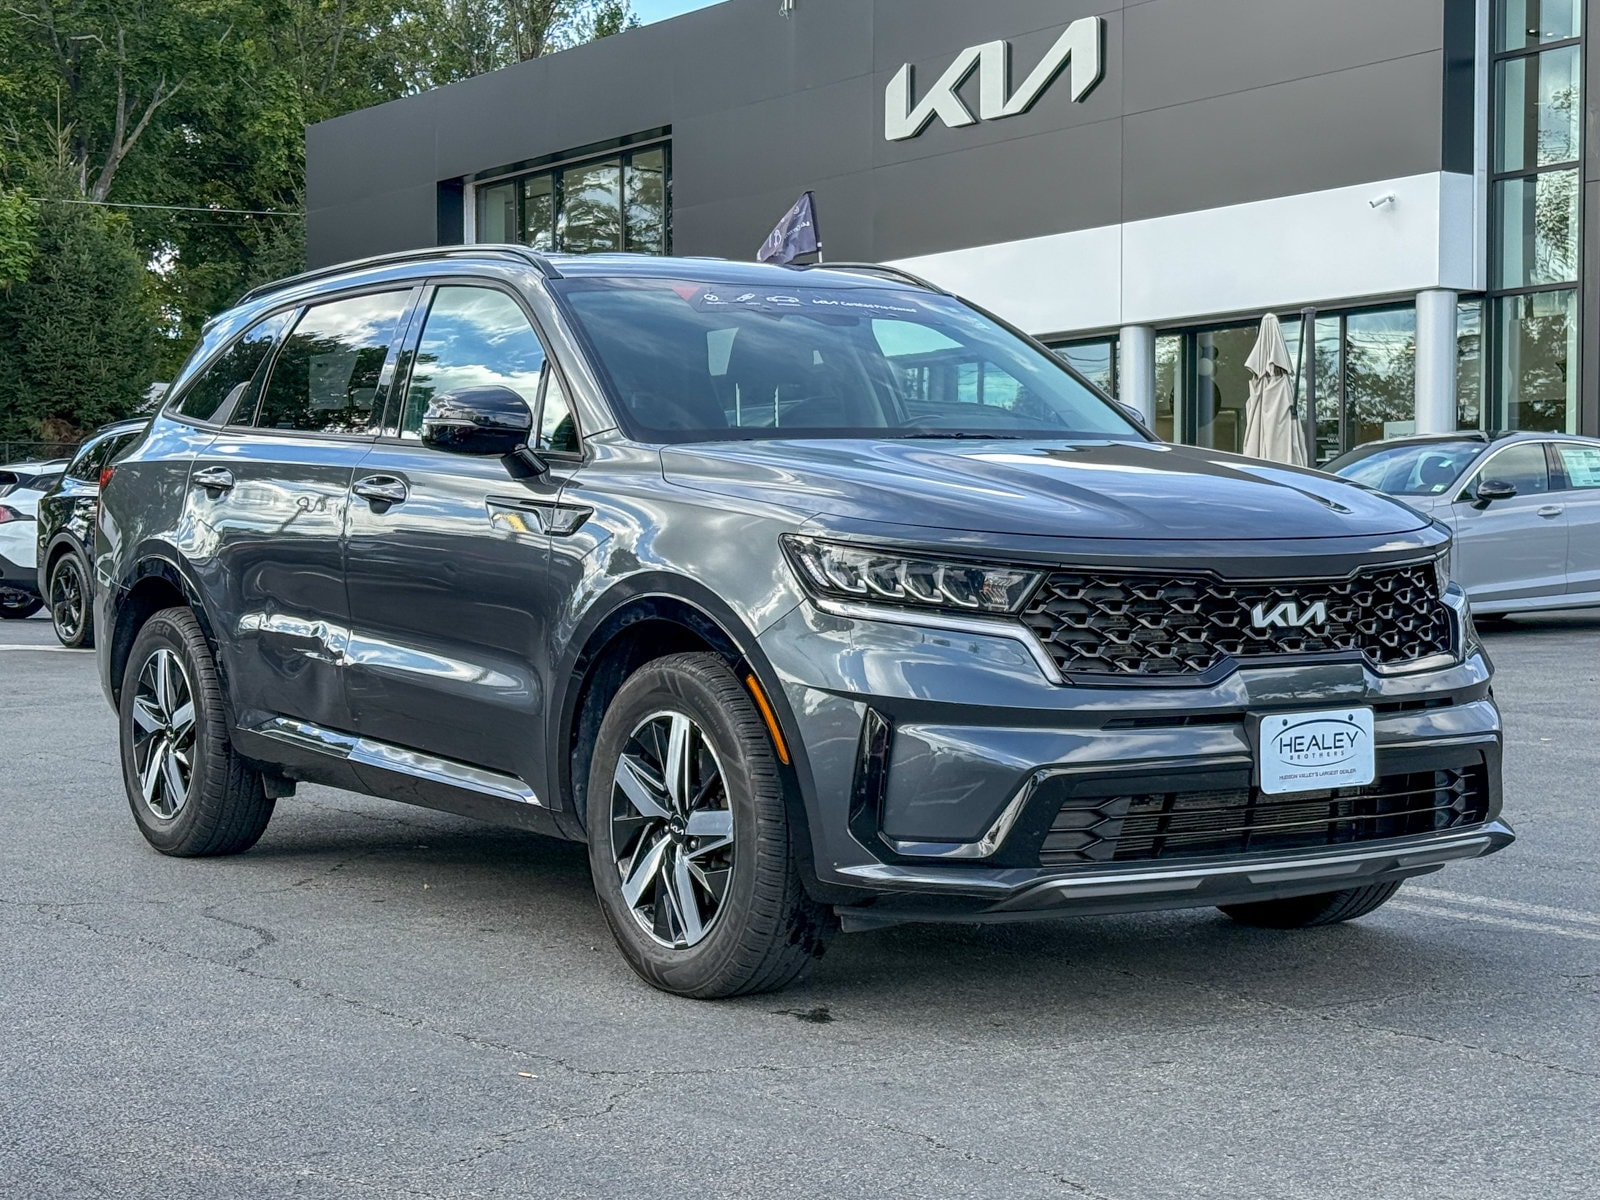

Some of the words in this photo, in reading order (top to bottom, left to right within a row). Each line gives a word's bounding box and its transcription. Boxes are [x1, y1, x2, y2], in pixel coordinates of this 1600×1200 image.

[885, 16, 1104, 141] KIA
[1251, 601, 1327, 629] KIA
[1279, 731, 1359, 754] HEALEY
[1289, 751, 1345, 760] BROTHERS
[1319, 769, 1339, 777] LARGEST
[1339, 767, 1357, 775] DEALER
